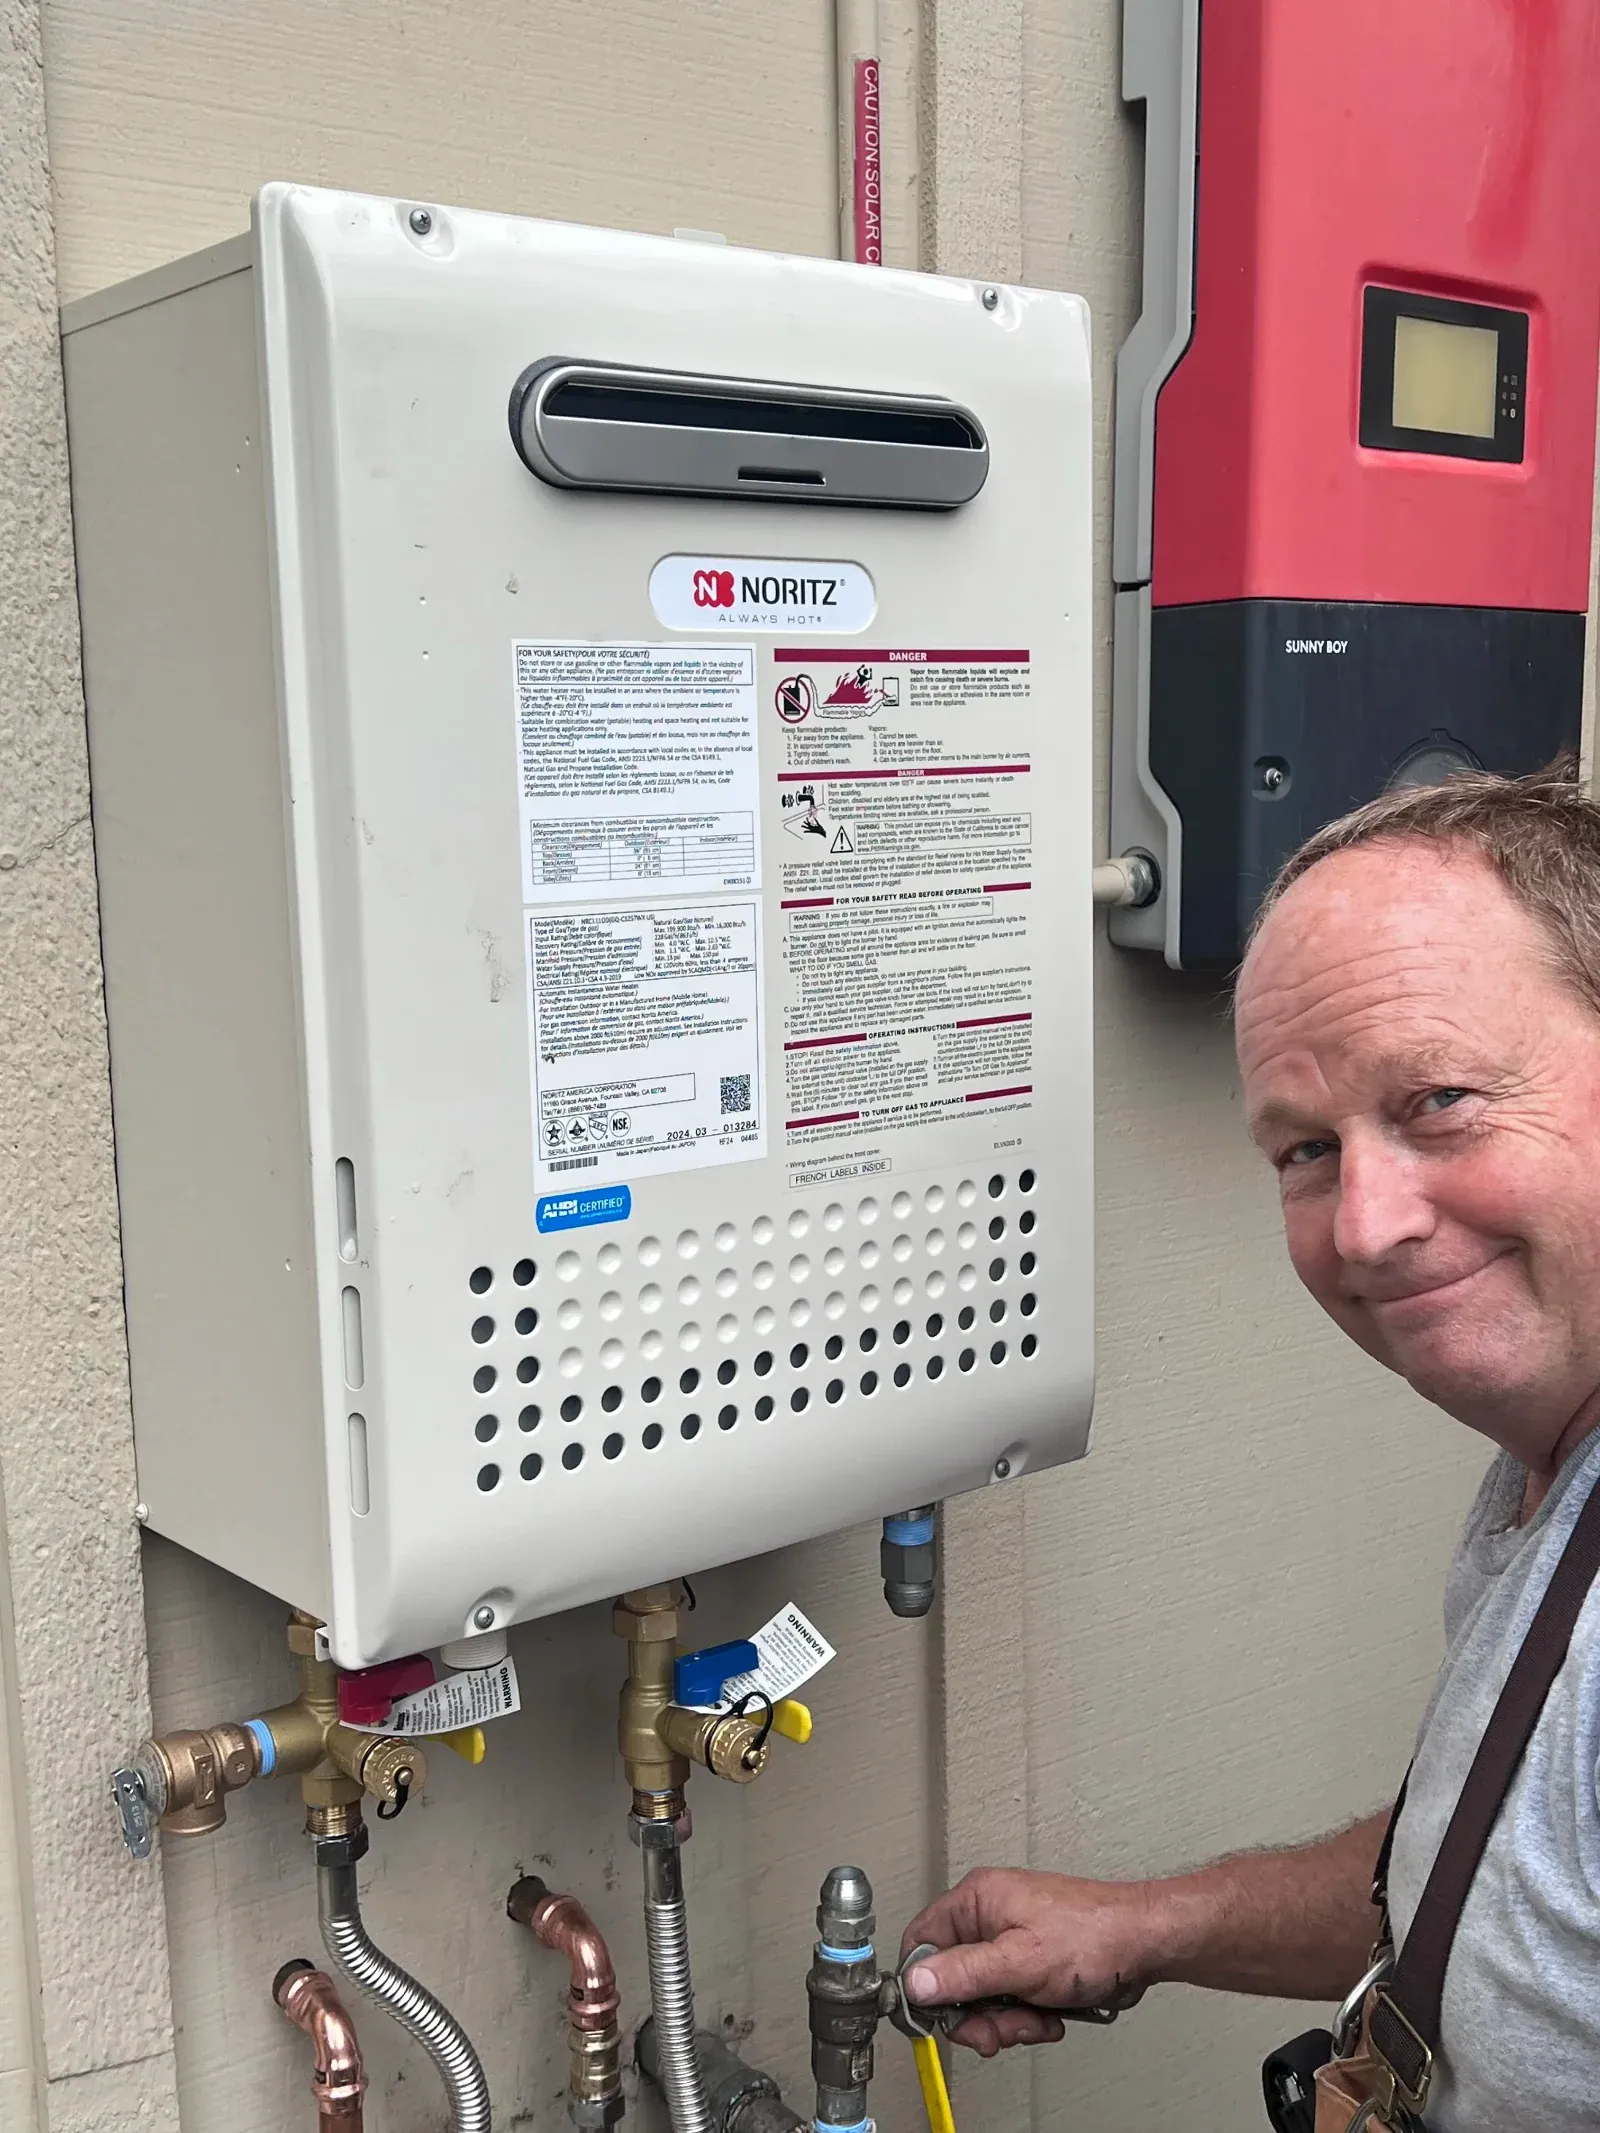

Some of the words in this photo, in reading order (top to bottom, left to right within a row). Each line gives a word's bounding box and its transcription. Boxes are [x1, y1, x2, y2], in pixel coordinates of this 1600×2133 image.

[866, 246, 880, 266] C
[742, 577, 837, 606] NORITZ
[719, 614, 778, 624] ALWAYS
[1286, 640, 1324, 654] SUNNY
[1326, 640, 1348, 654] BOY
[889, 652, 928, 662] DANGER
[945, 887, 982, 896] OPERATING
[868, 1029, 905, 1039] OPERATING
[907, 1023, 955, 1034] INSTRUCTIONS
[543, 1090, 565, 1099] NORITZ
[566, 1087, 593, 1096] AMERICA
[593, 1082, 637, 1093] CORPORATION
[872, 1108, 889, 1116] TURN
[929, 1096, 964, 1107] APPLIANCE
[612, 1117, 628, 1132] NSF
[724, 1120, 757, 1132] 013284
[795, 1170, 826, 1183] FRENCH
[830, 1166, 858, 1178] LABELS
[861, 1162, 886, 1174] INSIDE
[542, 1200, 578, 1219] AHRI
[580, 1198, 622, 1213] CERTIFIED
[787, 1614, 825, 1658] WARNING
[500, 1666, 513, 1709] WARNING
